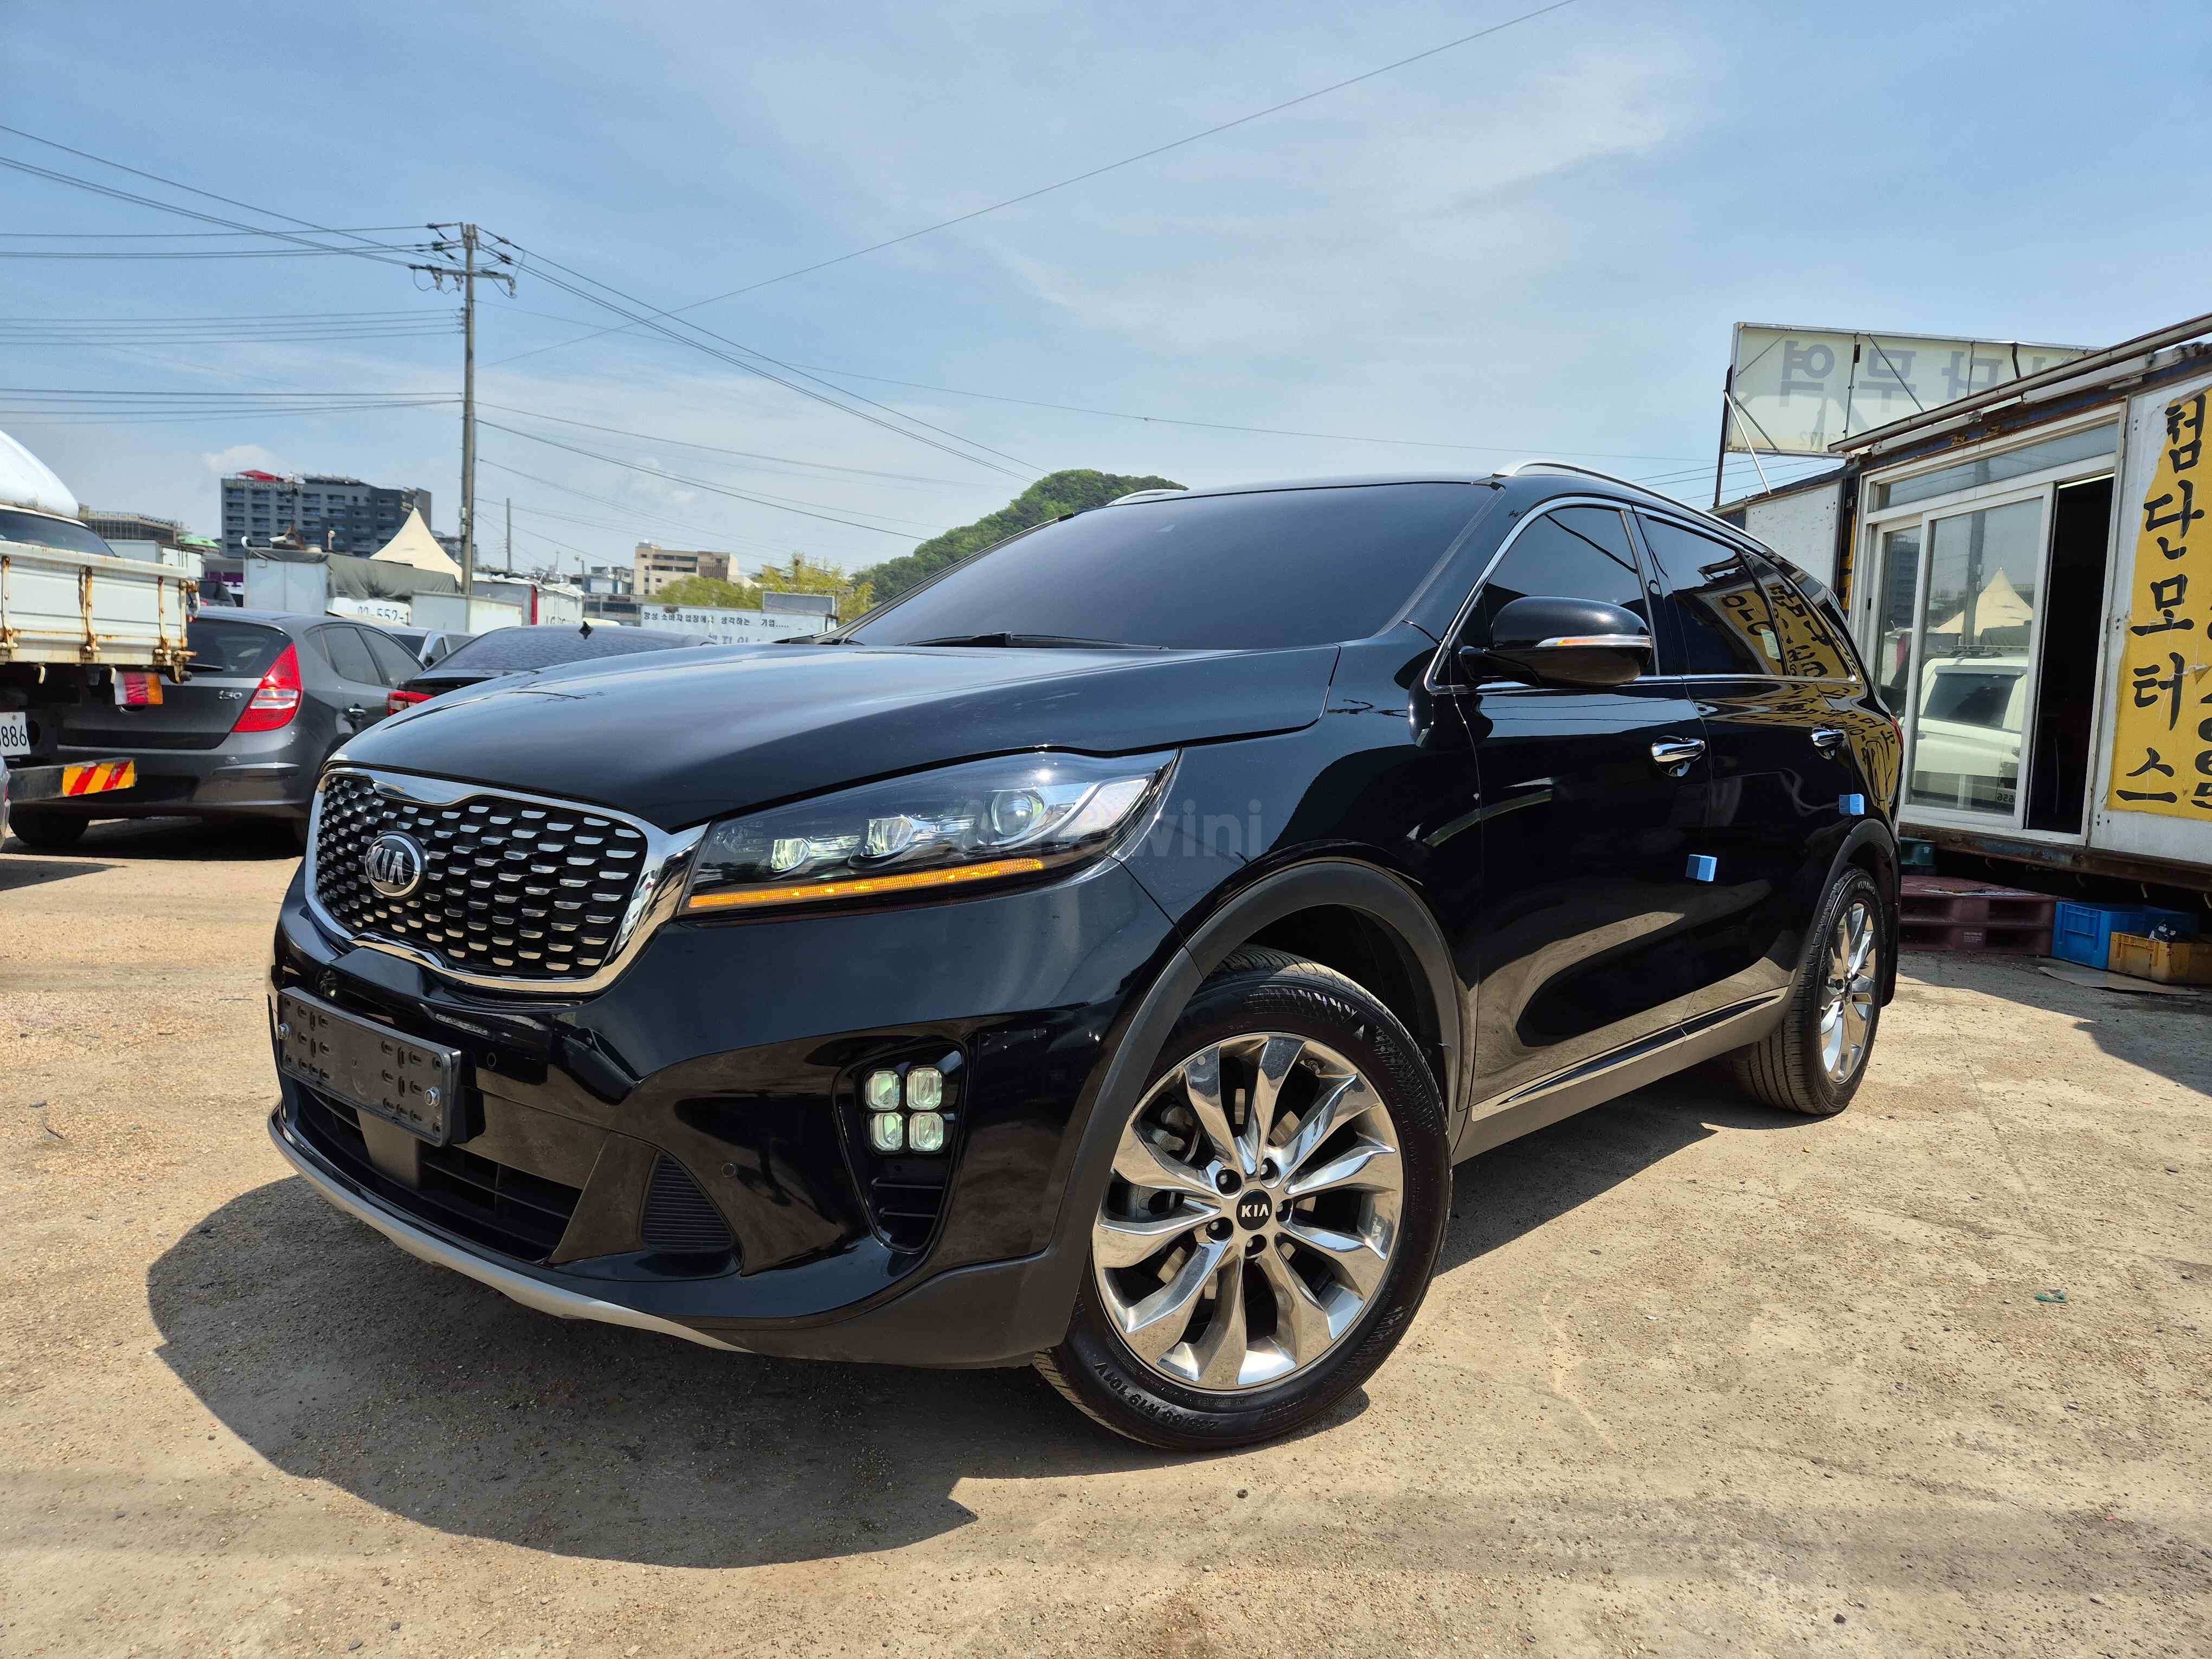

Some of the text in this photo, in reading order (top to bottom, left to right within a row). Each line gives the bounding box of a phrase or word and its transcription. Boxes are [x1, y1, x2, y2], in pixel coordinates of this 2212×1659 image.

[2115, 393, 2206, 803] 첨단모터스
[644, 612, 658, 620] 항상
[721, 616, 750, 626] 생각하는
[0, 724, 27, 748] 886
[369, 844, 406, 885] KIA
[1241, 1204, 1269, 1218] KIA
